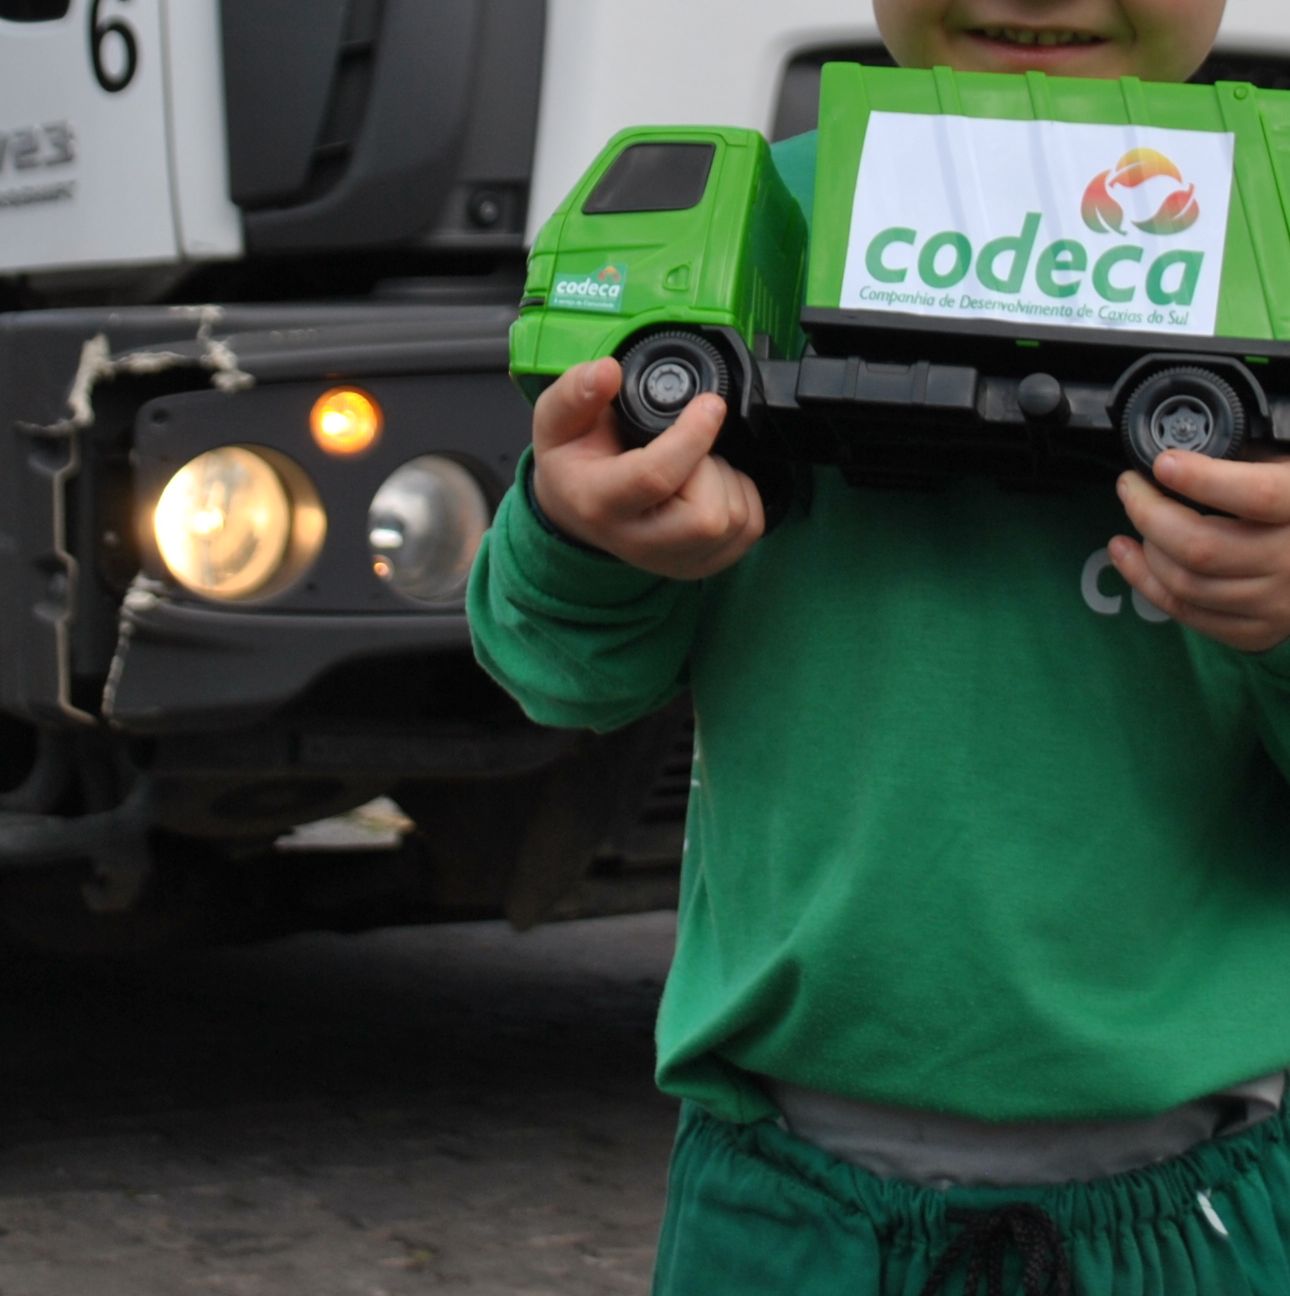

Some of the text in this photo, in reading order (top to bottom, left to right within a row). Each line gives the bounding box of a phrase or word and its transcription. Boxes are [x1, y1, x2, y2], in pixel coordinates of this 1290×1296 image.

[865, 212, 1205, 306] codeca
[556, 277, 621, 298] codeca
[859, 286, 1190, 326] Companhia de Desenvolvimento de Caxias do Sul
